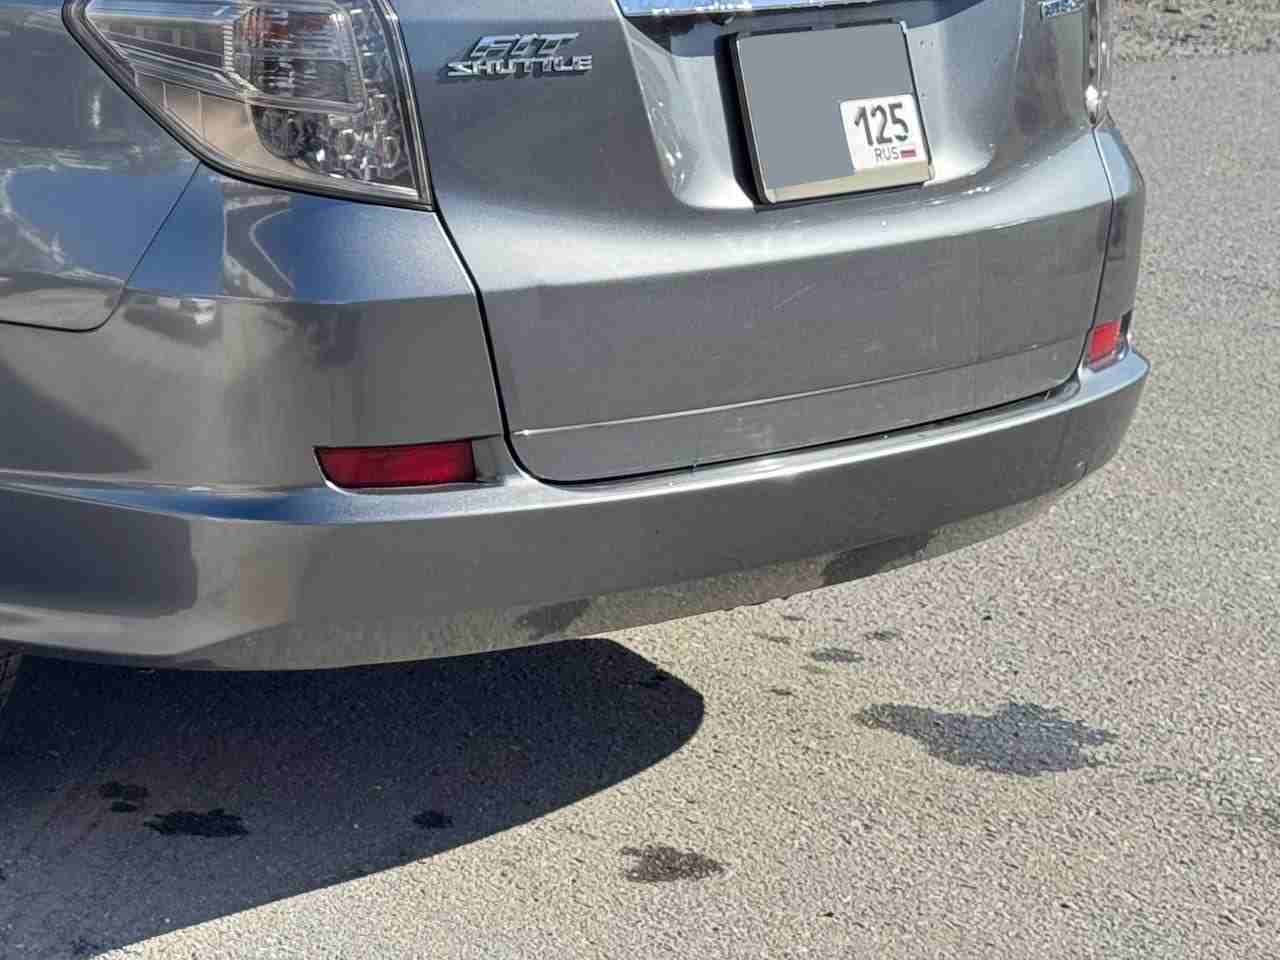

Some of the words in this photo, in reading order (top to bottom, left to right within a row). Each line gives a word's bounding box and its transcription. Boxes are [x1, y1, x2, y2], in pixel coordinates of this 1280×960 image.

[447, 54, 593, 77] SHUTTLE
[853, 102, 909, 147] 125
[874, 146, 899, 163] RUS
